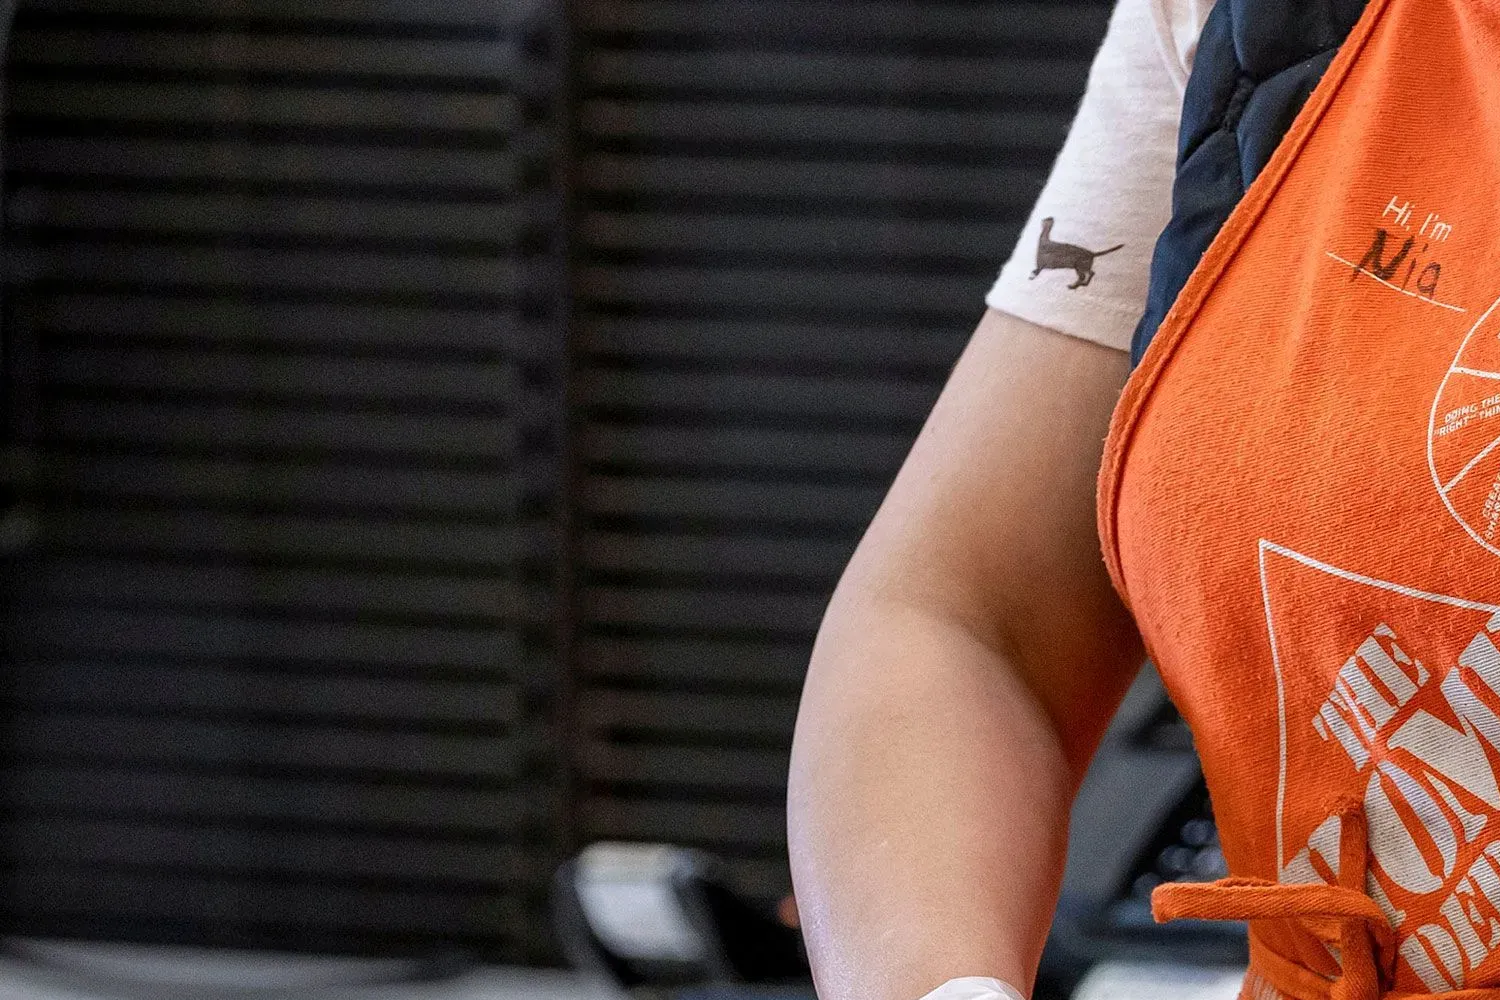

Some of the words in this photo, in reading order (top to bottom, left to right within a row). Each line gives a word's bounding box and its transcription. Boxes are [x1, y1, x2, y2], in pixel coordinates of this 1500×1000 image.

[1419, 213, 1452, 242] I'm
[1444, 403, 1478, 423] DOING
[1481, 394, 1500, 408] THE
[1312, 622, 1430, 772] THE
